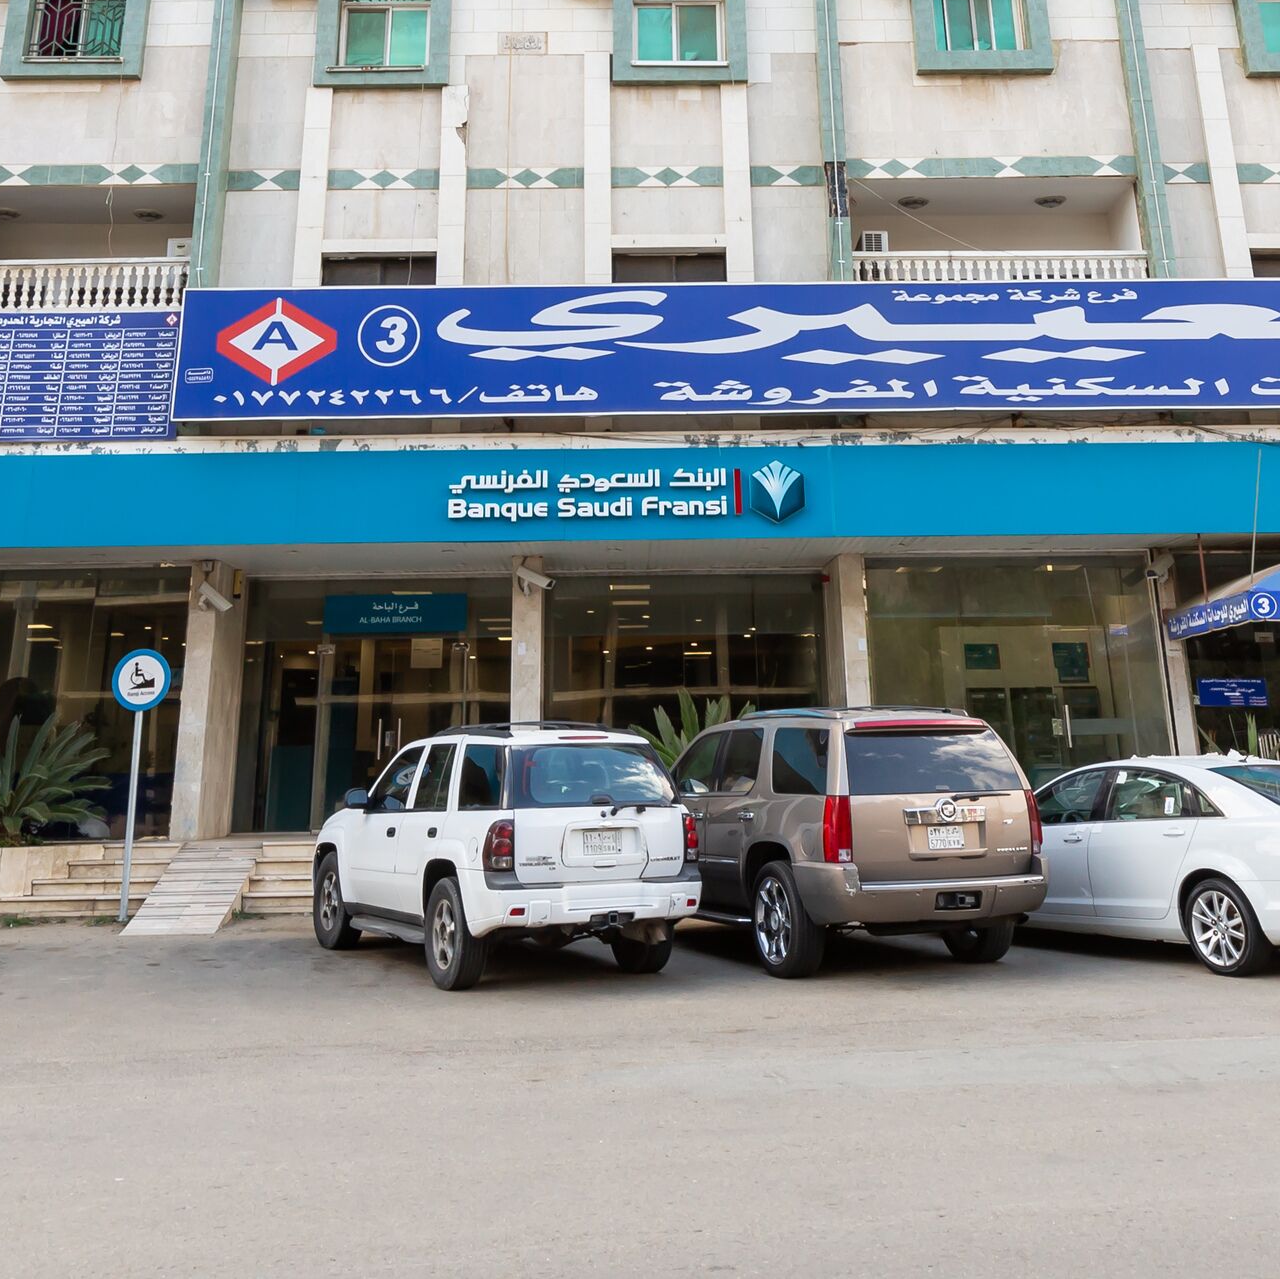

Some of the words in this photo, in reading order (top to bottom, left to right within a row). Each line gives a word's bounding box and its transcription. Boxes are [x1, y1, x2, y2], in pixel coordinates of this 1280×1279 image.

[892, 287, 1001, 304] مجموعة
[1009, 287, 1081, 304] شركة
[1087, 287, 1138, 304] فرع
[252, 321, 298, 350] A
[375, 316, 407, 354] 3
[653, 377, 939, 407] المفروشة
[952, 375, 1230, 401] السكنية
[448, 469, 548, 494] الفرنسي
[557, 468, 661, 493] السعودي
[669, 468, 726, 491] البنك
[447, 498, 548, 522] Banque
[557, 497, 633, 518] Saudi
[641, 495, 727, 517] Fransi
[372, 602, 397, 613] الباحة
[398, 602, 419, 613] فرع
[1257, 598, 1270, 614] 3
